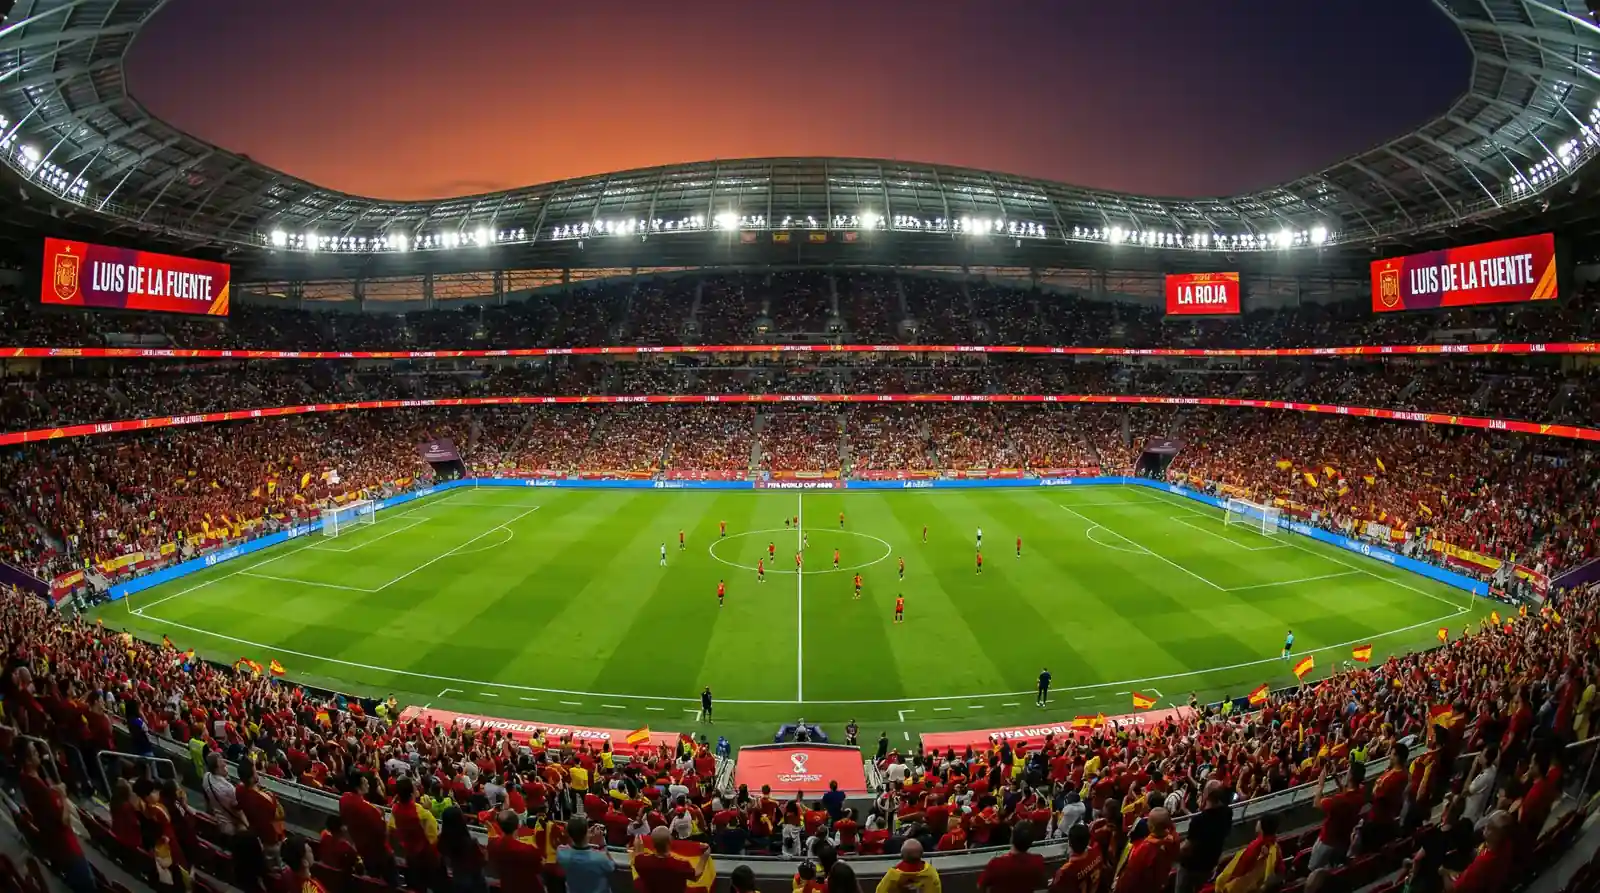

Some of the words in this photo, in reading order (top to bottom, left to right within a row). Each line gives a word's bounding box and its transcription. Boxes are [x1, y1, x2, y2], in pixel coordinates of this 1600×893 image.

[92, 261, 125, 293] LUIS
[127, 265, 144, 295] DE
[147, 267, 163, 296] LA
[166, 271, 213, 301] FUENTE
[1410, 266, 1438, 295] LUIS
[1440, 263, 1458, 292] DE
[1460, 260, 1478, 290] LA
[1480, 253, 1534, 288] FUENTE
[1177, 285, 1193, 304] LA
[1195, 284, 1227, 304] ROJA
[482, 720, 537, 732] WORLD
[572, 729, 611, 739] 2026
[989, 730, 1025, 740] FIFA
[1024, 725, 1078, 737] WORL
